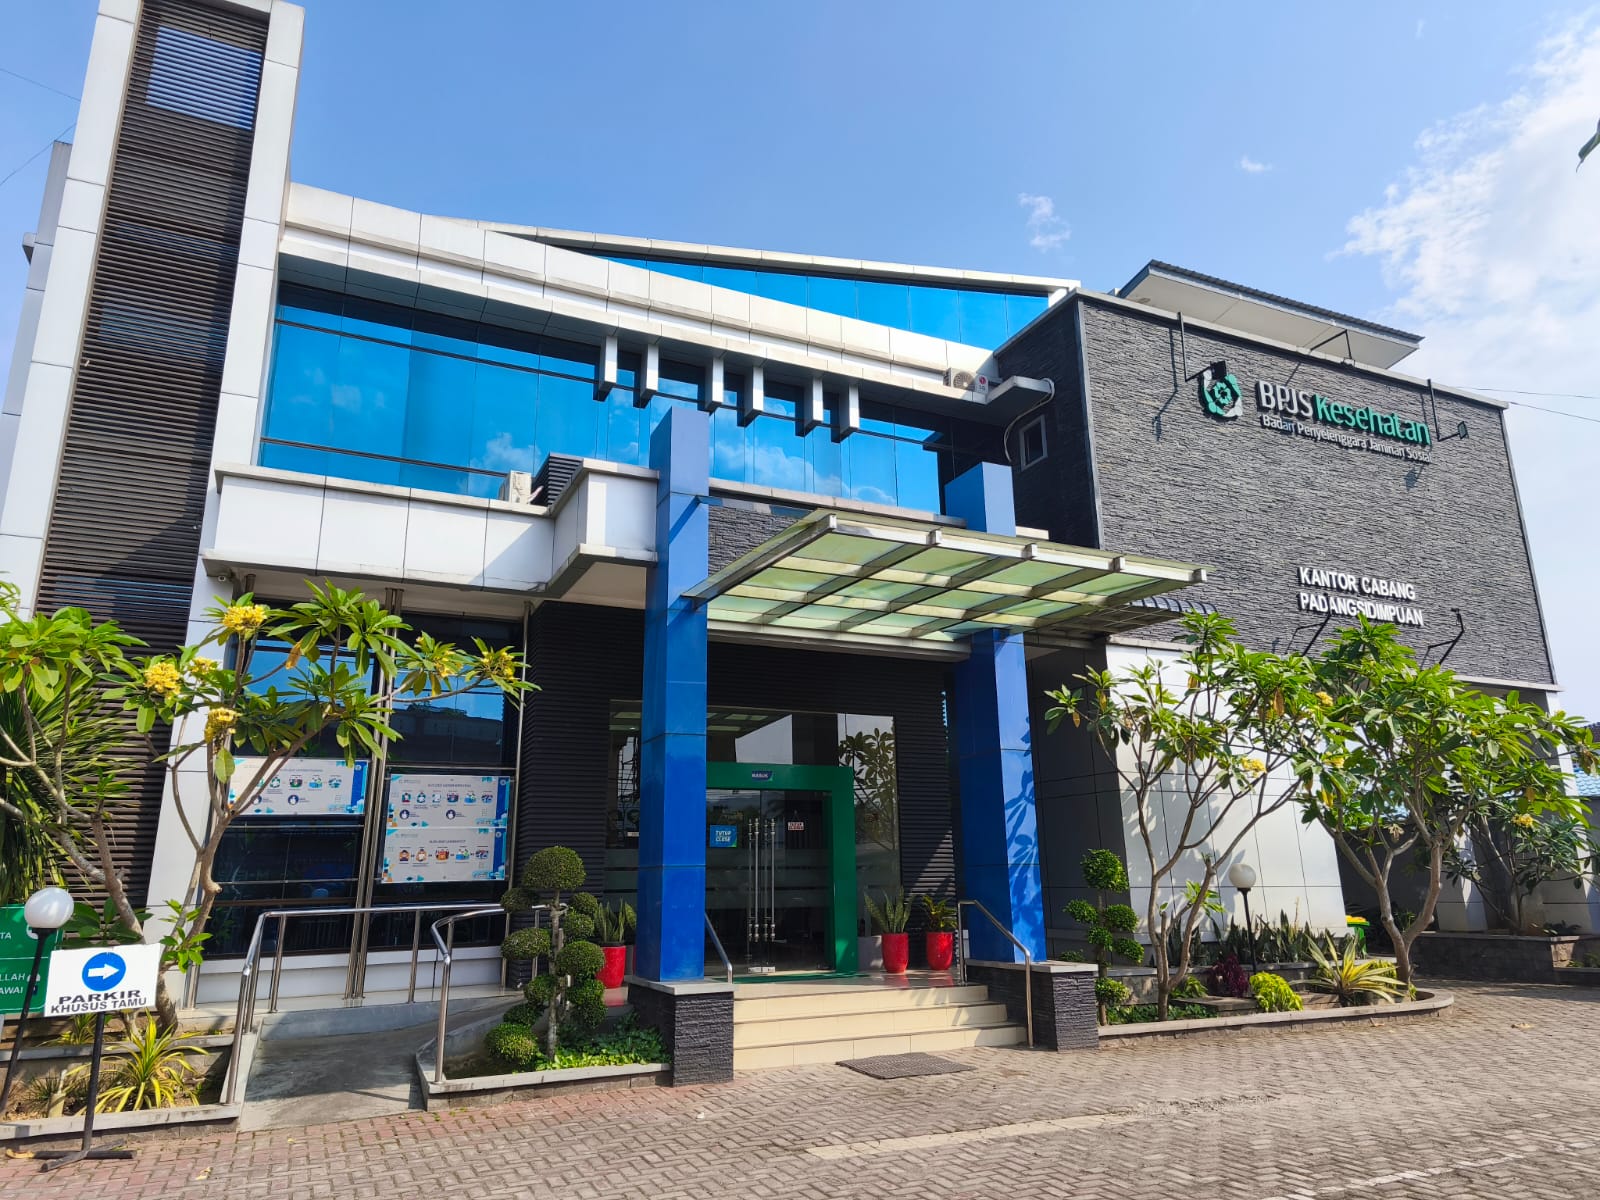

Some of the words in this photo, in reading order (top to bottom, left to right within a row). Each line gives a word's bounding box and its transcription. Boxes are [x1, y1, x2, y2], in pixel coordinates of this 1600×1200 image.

[1258, 380, 1313, 418] BPJS
[1314, 394, 1431, 445] Kesehatan
[1262, 415, 1295, 433] Badan
[1297, 421, 1367, 448] Penyelenggara
[1369, 438, 1405, 457] Jaminan
[1406, 447, 1432, 463] Sosial
[1299, 566, 1358, 593] KANTOR
[1361, 576, 1416, 600] CABANG
[1299, 592, 1424, 626] PADANGSIDIMPUAN
[51, 1001, 108, 1014] KHUSUS
[111, 997, 147, 1009] TAMU
[58, 989, 141, 1005] PARKIR
